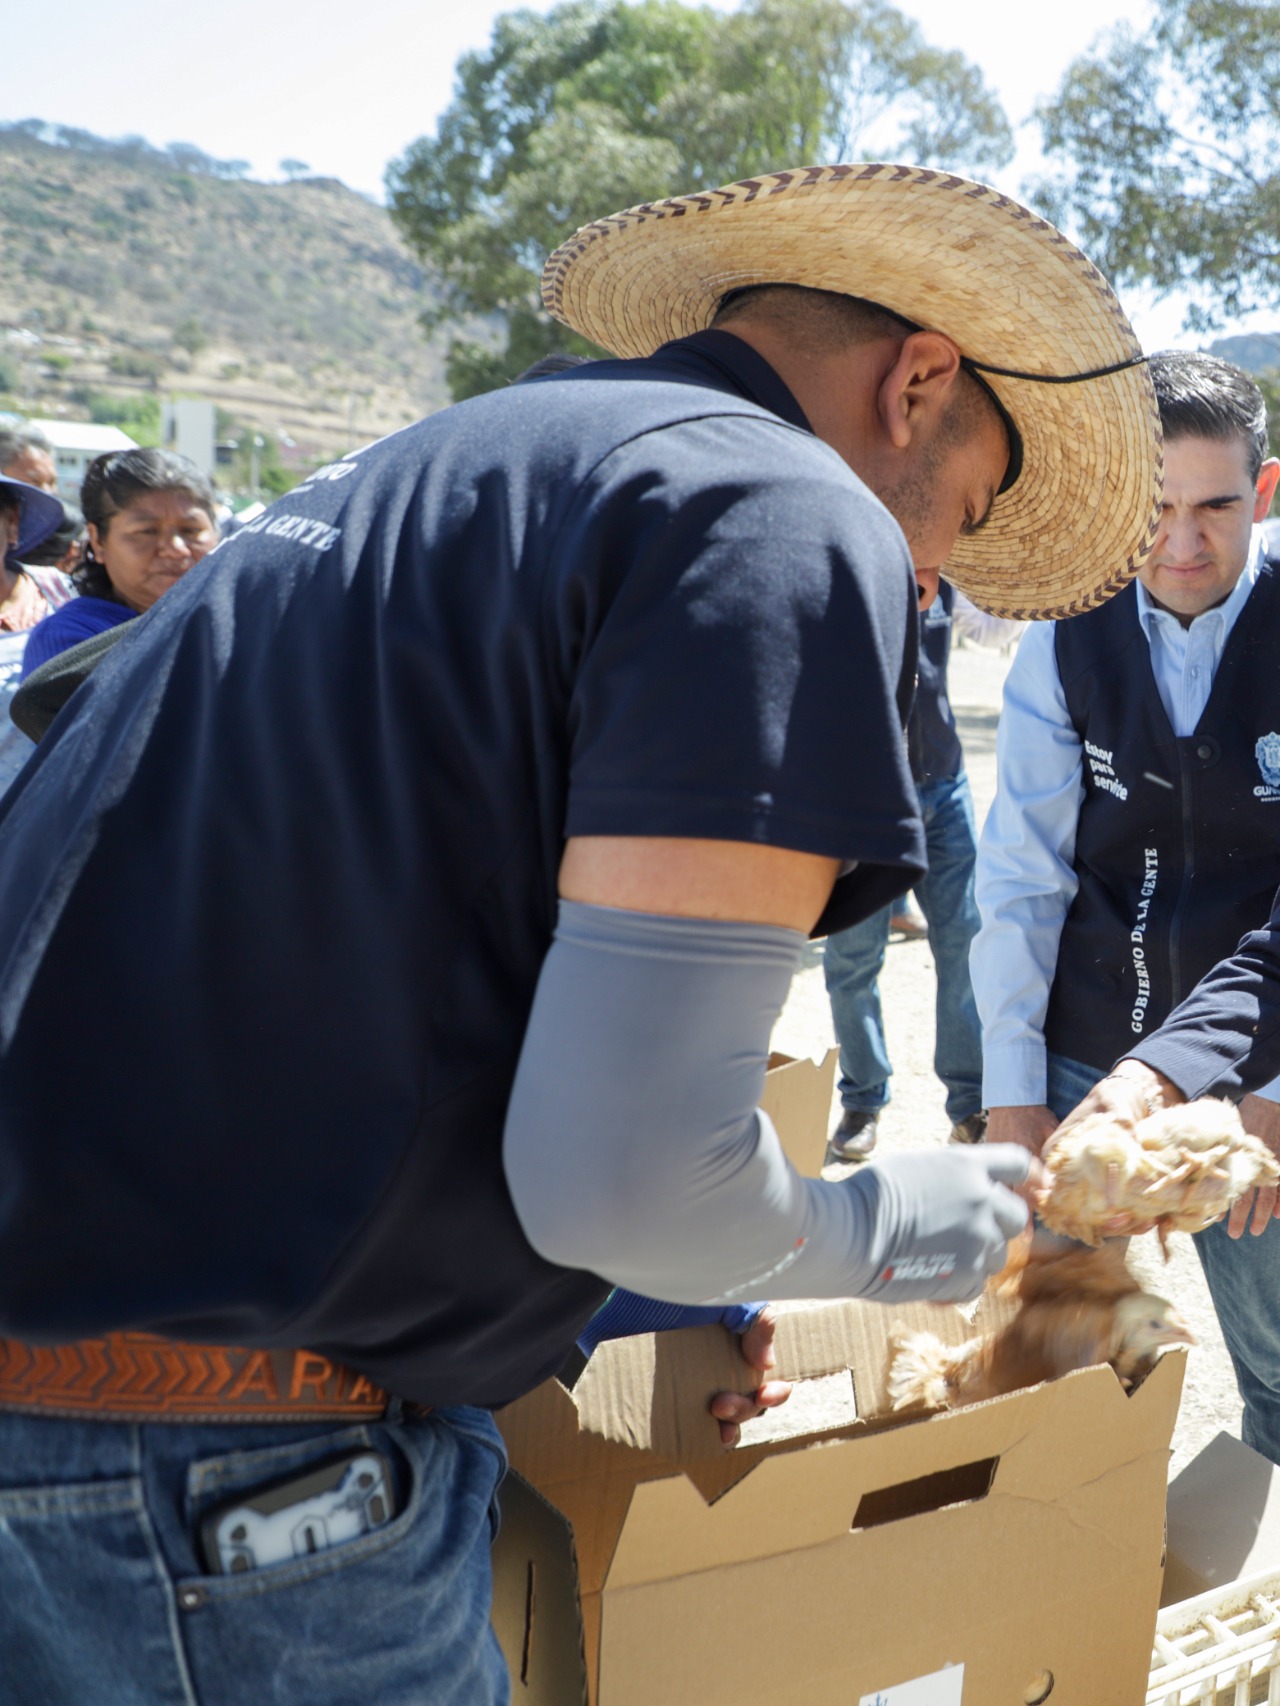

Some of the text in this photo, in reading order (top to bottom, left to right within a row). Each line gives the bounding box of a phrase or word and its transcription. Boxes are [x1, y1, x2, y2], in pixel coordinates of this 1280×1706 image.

[265, 514, 342, 552] GENTE
[1131, 848, 1158, 1033] GOBIERNO DE LA GENTE
